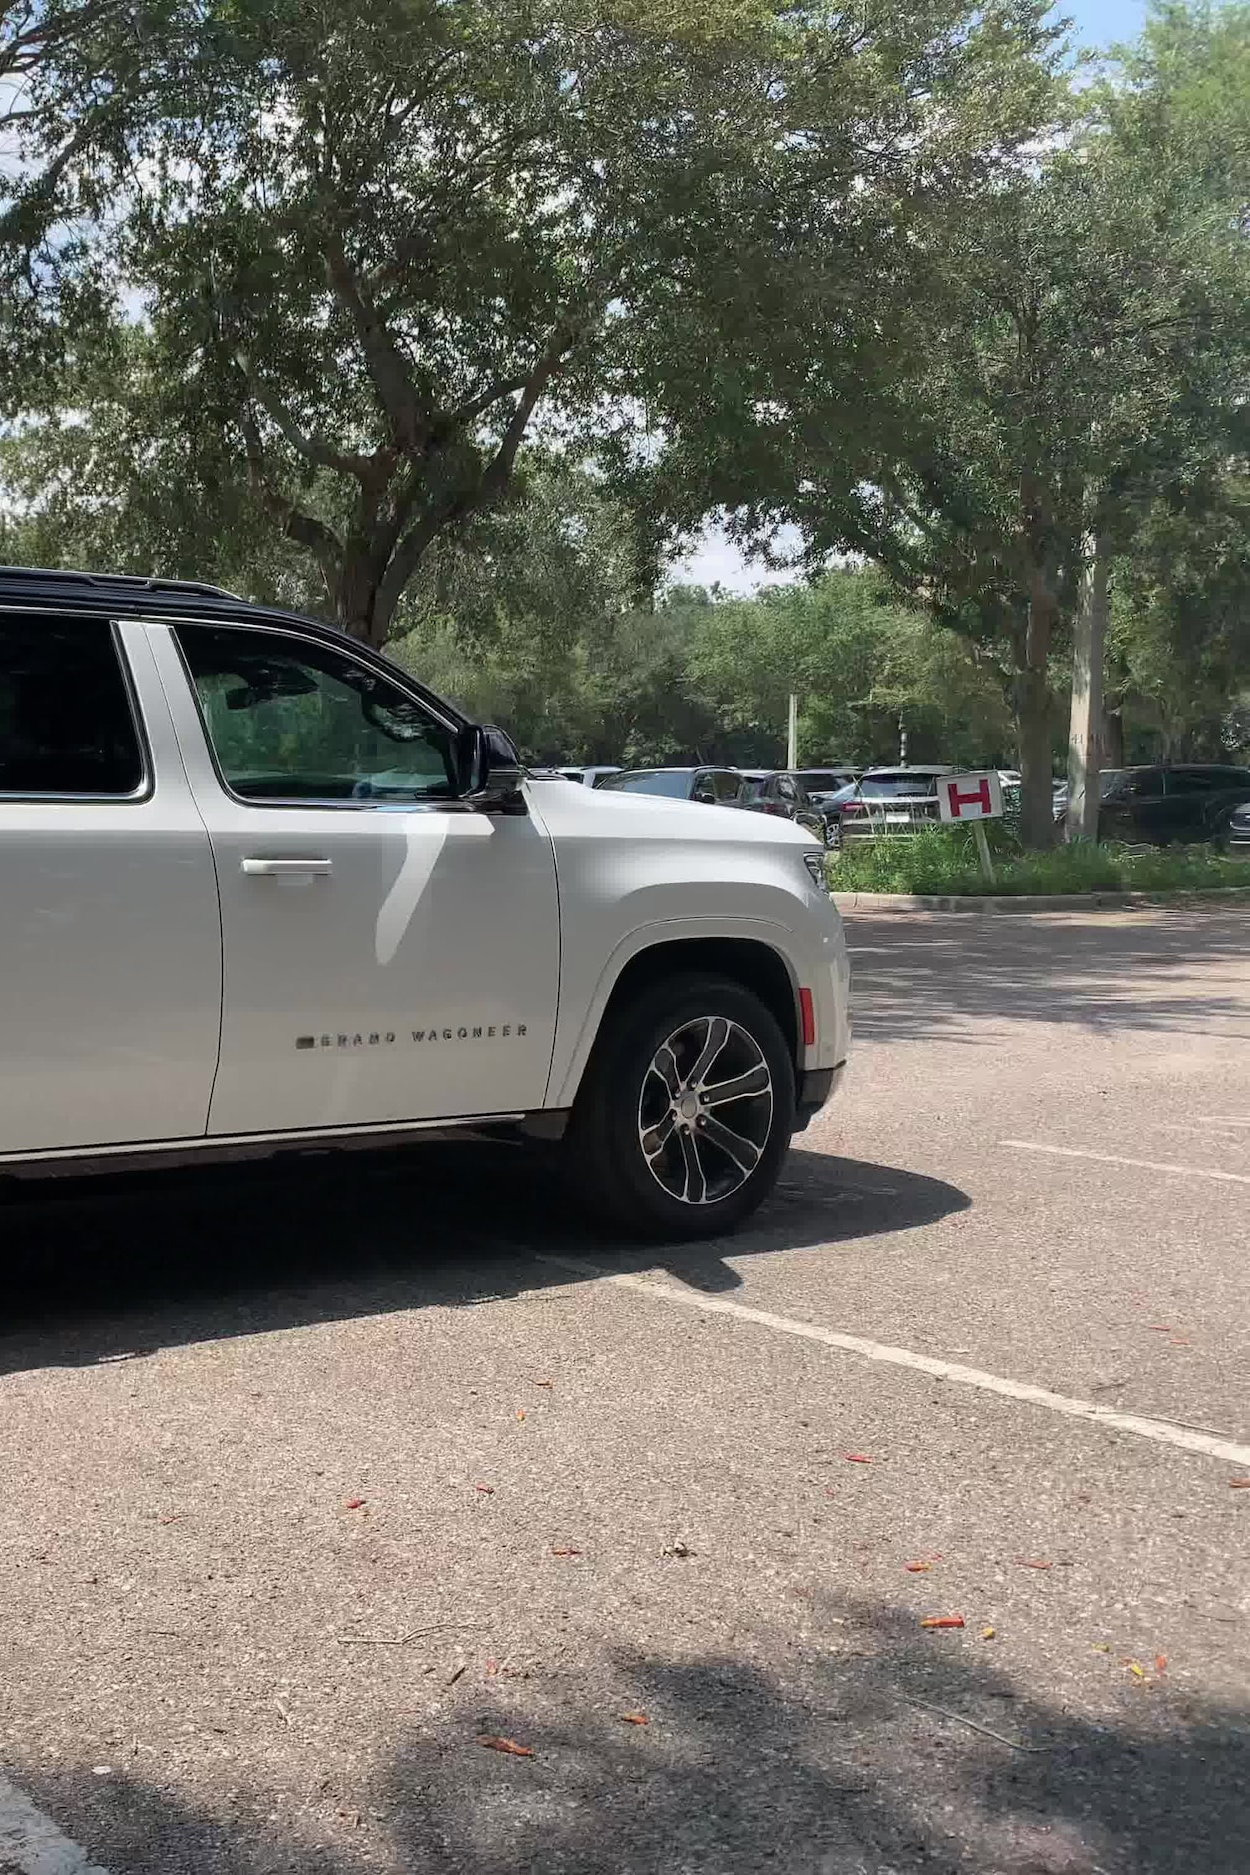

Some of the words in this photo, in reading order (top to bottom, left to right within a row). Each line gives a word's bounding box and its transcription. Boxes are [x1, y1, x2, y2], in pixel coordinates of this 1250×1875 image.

[948, 779, 991, 817] H
[320, 1032, 395, 1047] GRAND
[411, 1024, 527, 1042] WAGONEER
